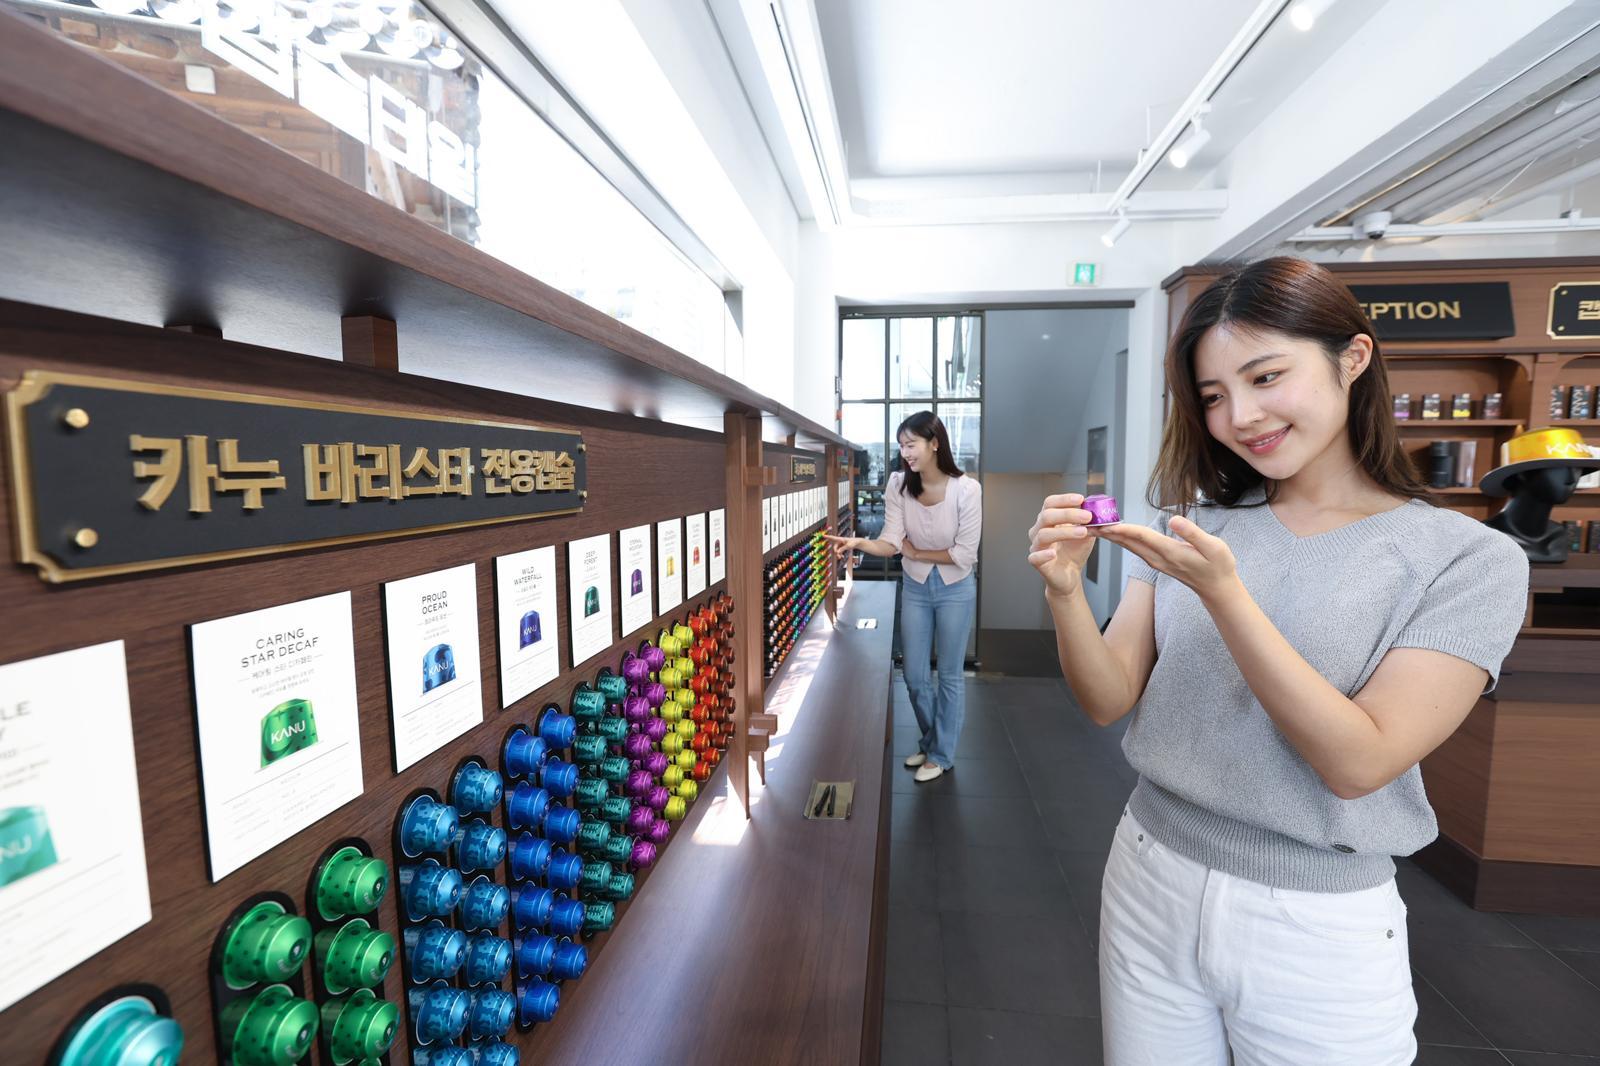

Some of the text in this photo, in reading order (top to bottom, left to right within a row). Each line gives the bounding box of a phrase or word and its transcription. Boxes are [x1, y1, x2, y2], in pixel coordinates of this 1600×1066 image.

[129, 434, 576, 513] 카누 바리스타 전용캡슐
[521, 566, 535, 575] WILD
[513, 573, 543, 586] WATERFALL
[421, 590, 448, 604] PROUD
[421, 600, 449, 615] OCEAN
[255, 628, 305, 650] CARING
[240, 636, 320, 668] STAR DECAF
[428, 660, 449, 675] KANU
[270, 720, 306, 745] KANU
